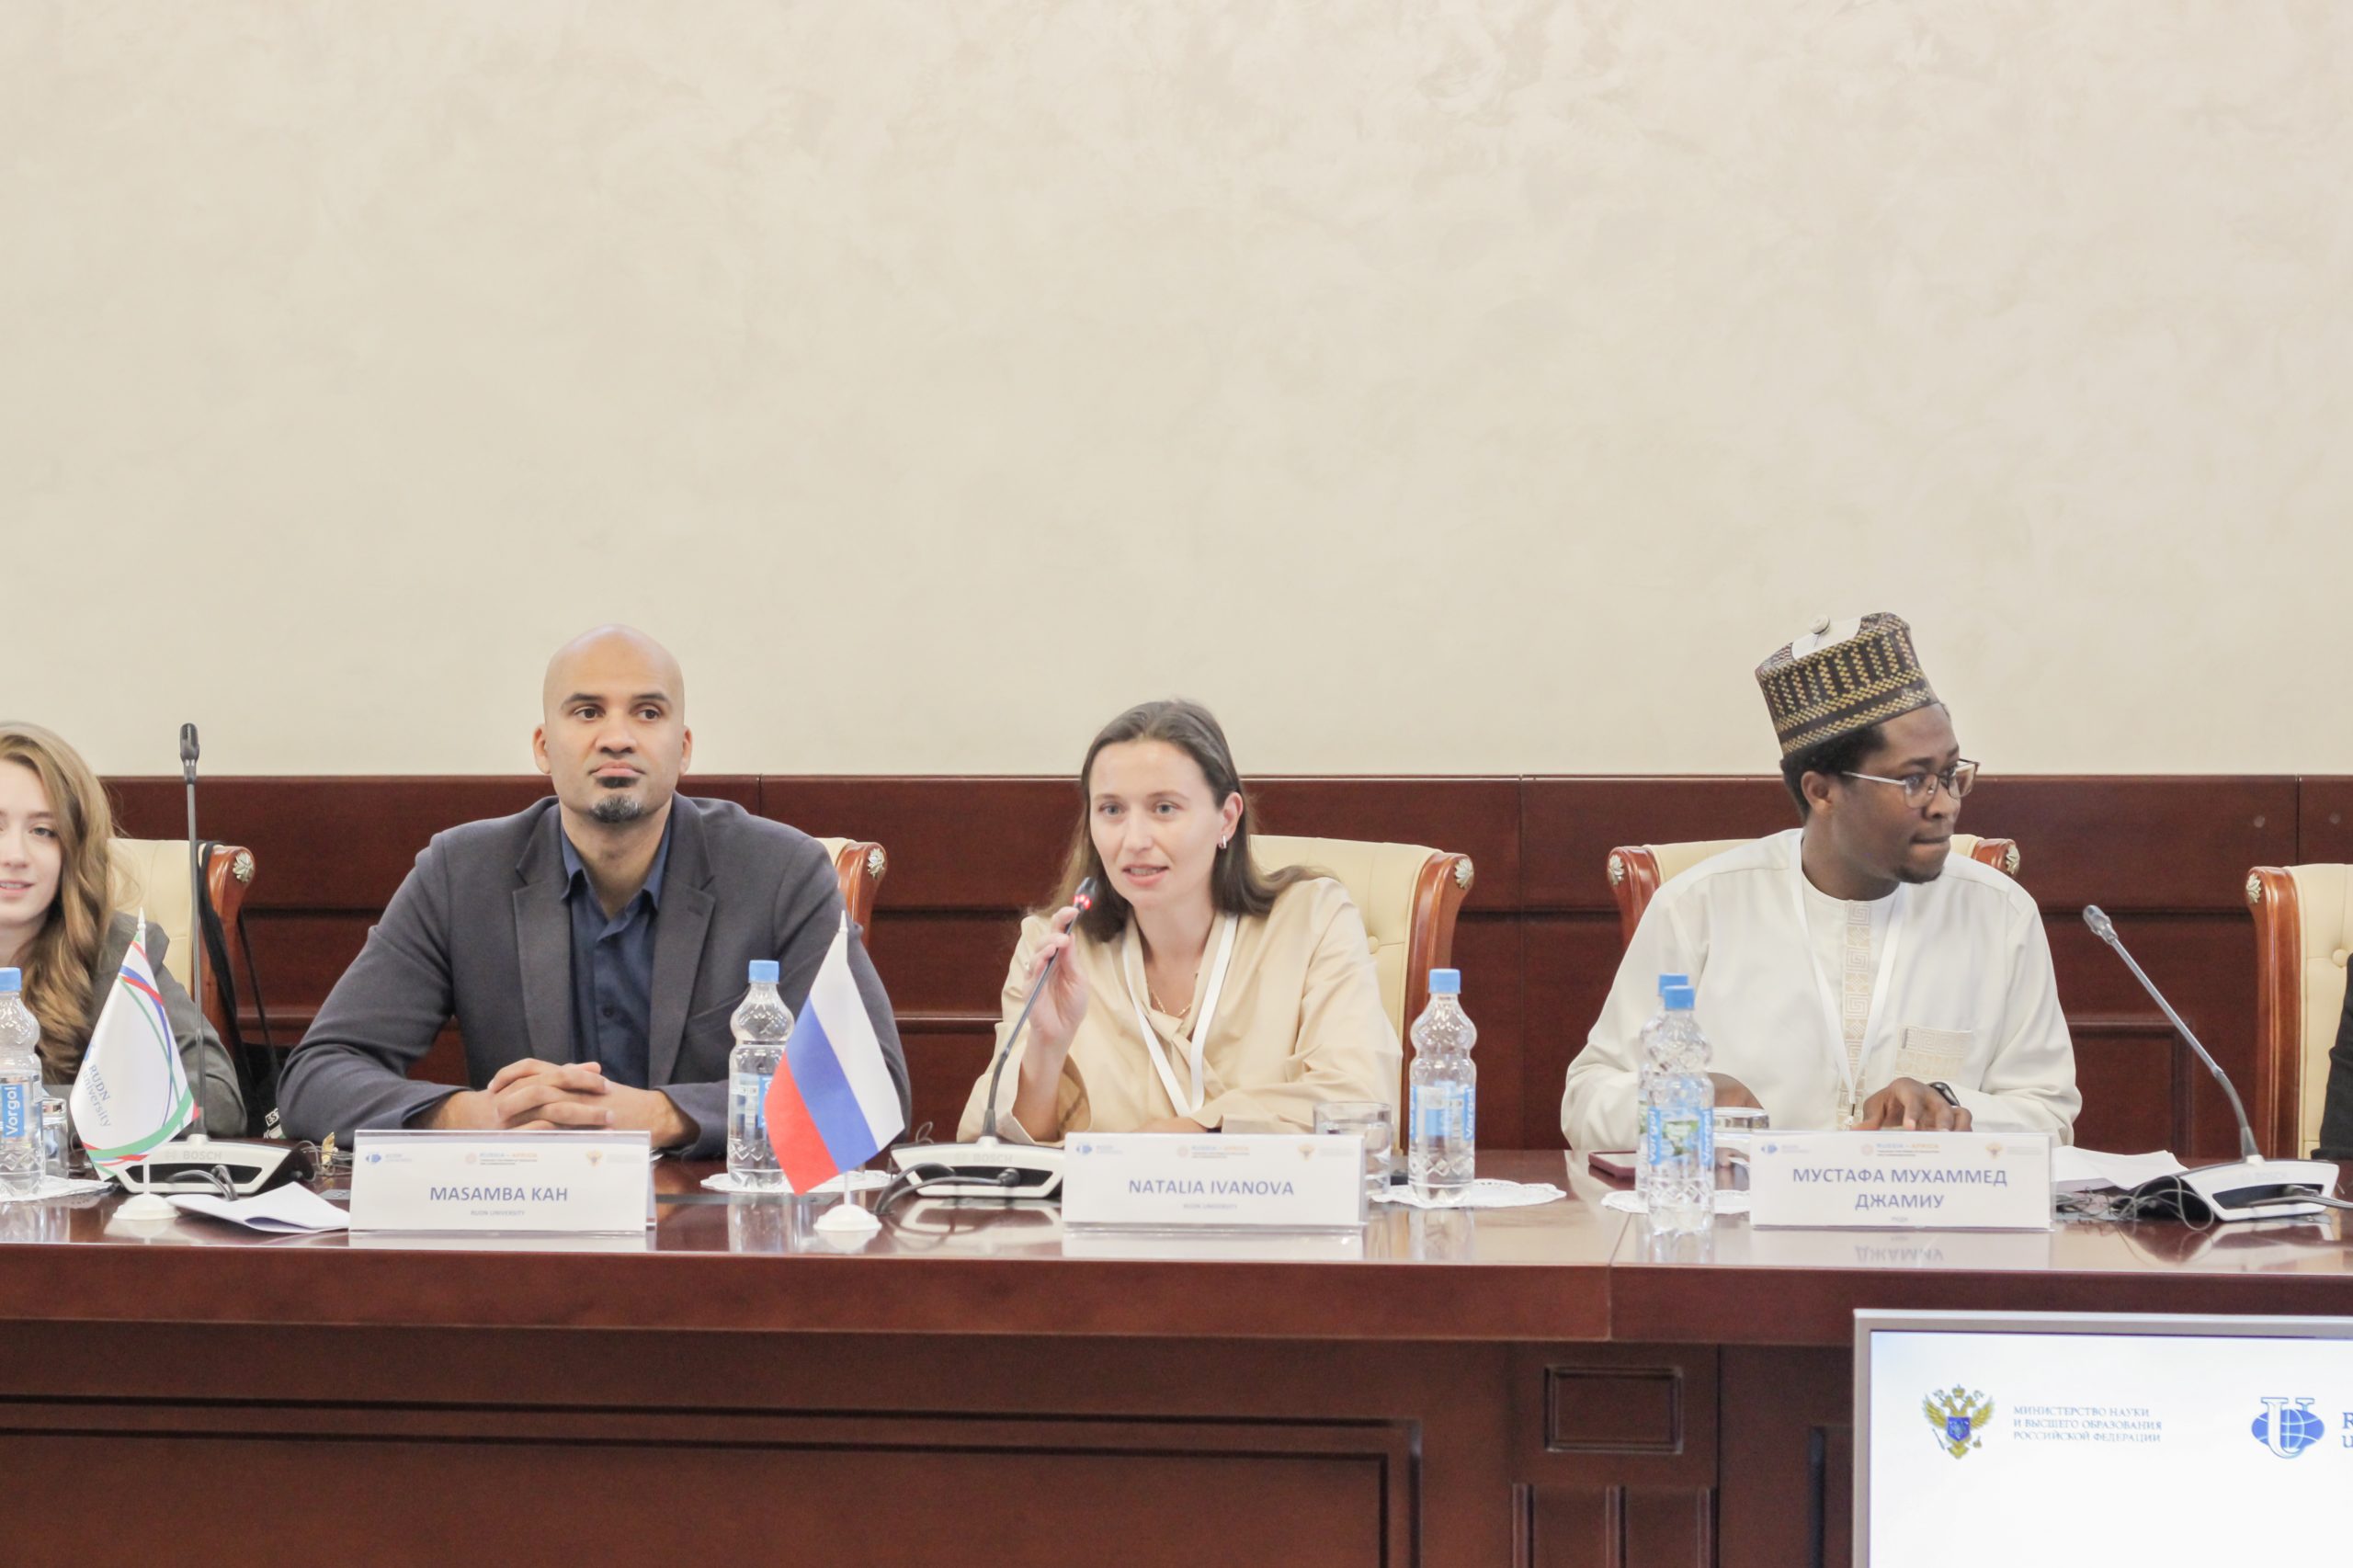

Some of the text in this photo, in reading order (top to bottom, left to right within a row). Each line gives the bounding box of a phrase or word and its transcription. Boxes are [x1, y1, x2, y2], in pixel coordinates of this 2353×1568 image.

[89, 1063, 110, 1101] RUDN
[183, 1150, 222, 1161] BOSCH
[1792, 1168, 2008, 1187] МУСТАФА МУХАММЕД
[429, 1187, 568, 1201] MASAMBA KAH
[1129, 1179, 1294, 1196] NATALIA IVANOVA
[1854, 1193, 1945, 1210] ДЖАМИУ
[2013, 1405, 2150, 1417] МИНИСТЕРСТВО НАУКИ
[2013, 1418, 2163, 1430] И ВЫСШЕГО ОБРАЗОВАНИЯ
[2013, 1430, 2162, 1443] РОССИЙСКОЙ ФЕДЕРАЦИИ
